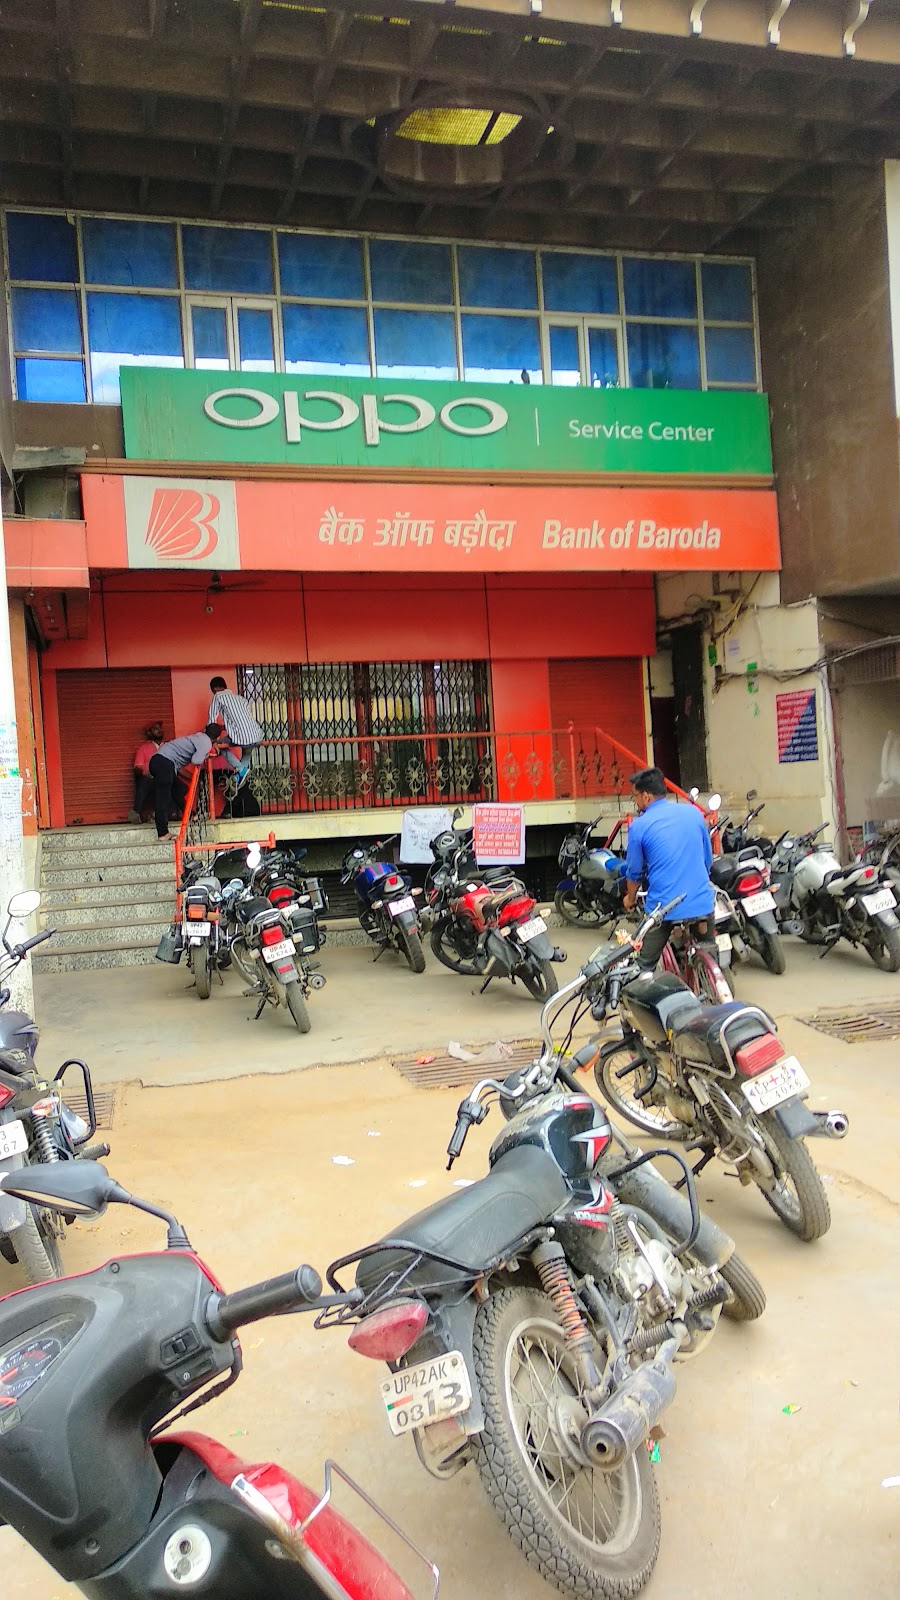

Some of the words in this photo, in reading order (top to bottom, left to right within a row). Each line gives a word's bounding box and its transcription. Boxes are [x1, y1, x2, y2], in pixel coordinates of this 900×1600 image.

[569, 419, 644, 440] Service
[648, 421, 715, 442] Center
[318, 505, 365, 546] बैंक
[372, 511, 436, 547] ऑफ
[444, 508, 518, 554] बड़ौदा
[542, 519, 606, 550] Bank
[609, 519, 635, 550] of
[637, 519, 722, 550] Baroda
[394, 1361, 448, 1395] UP42AK
